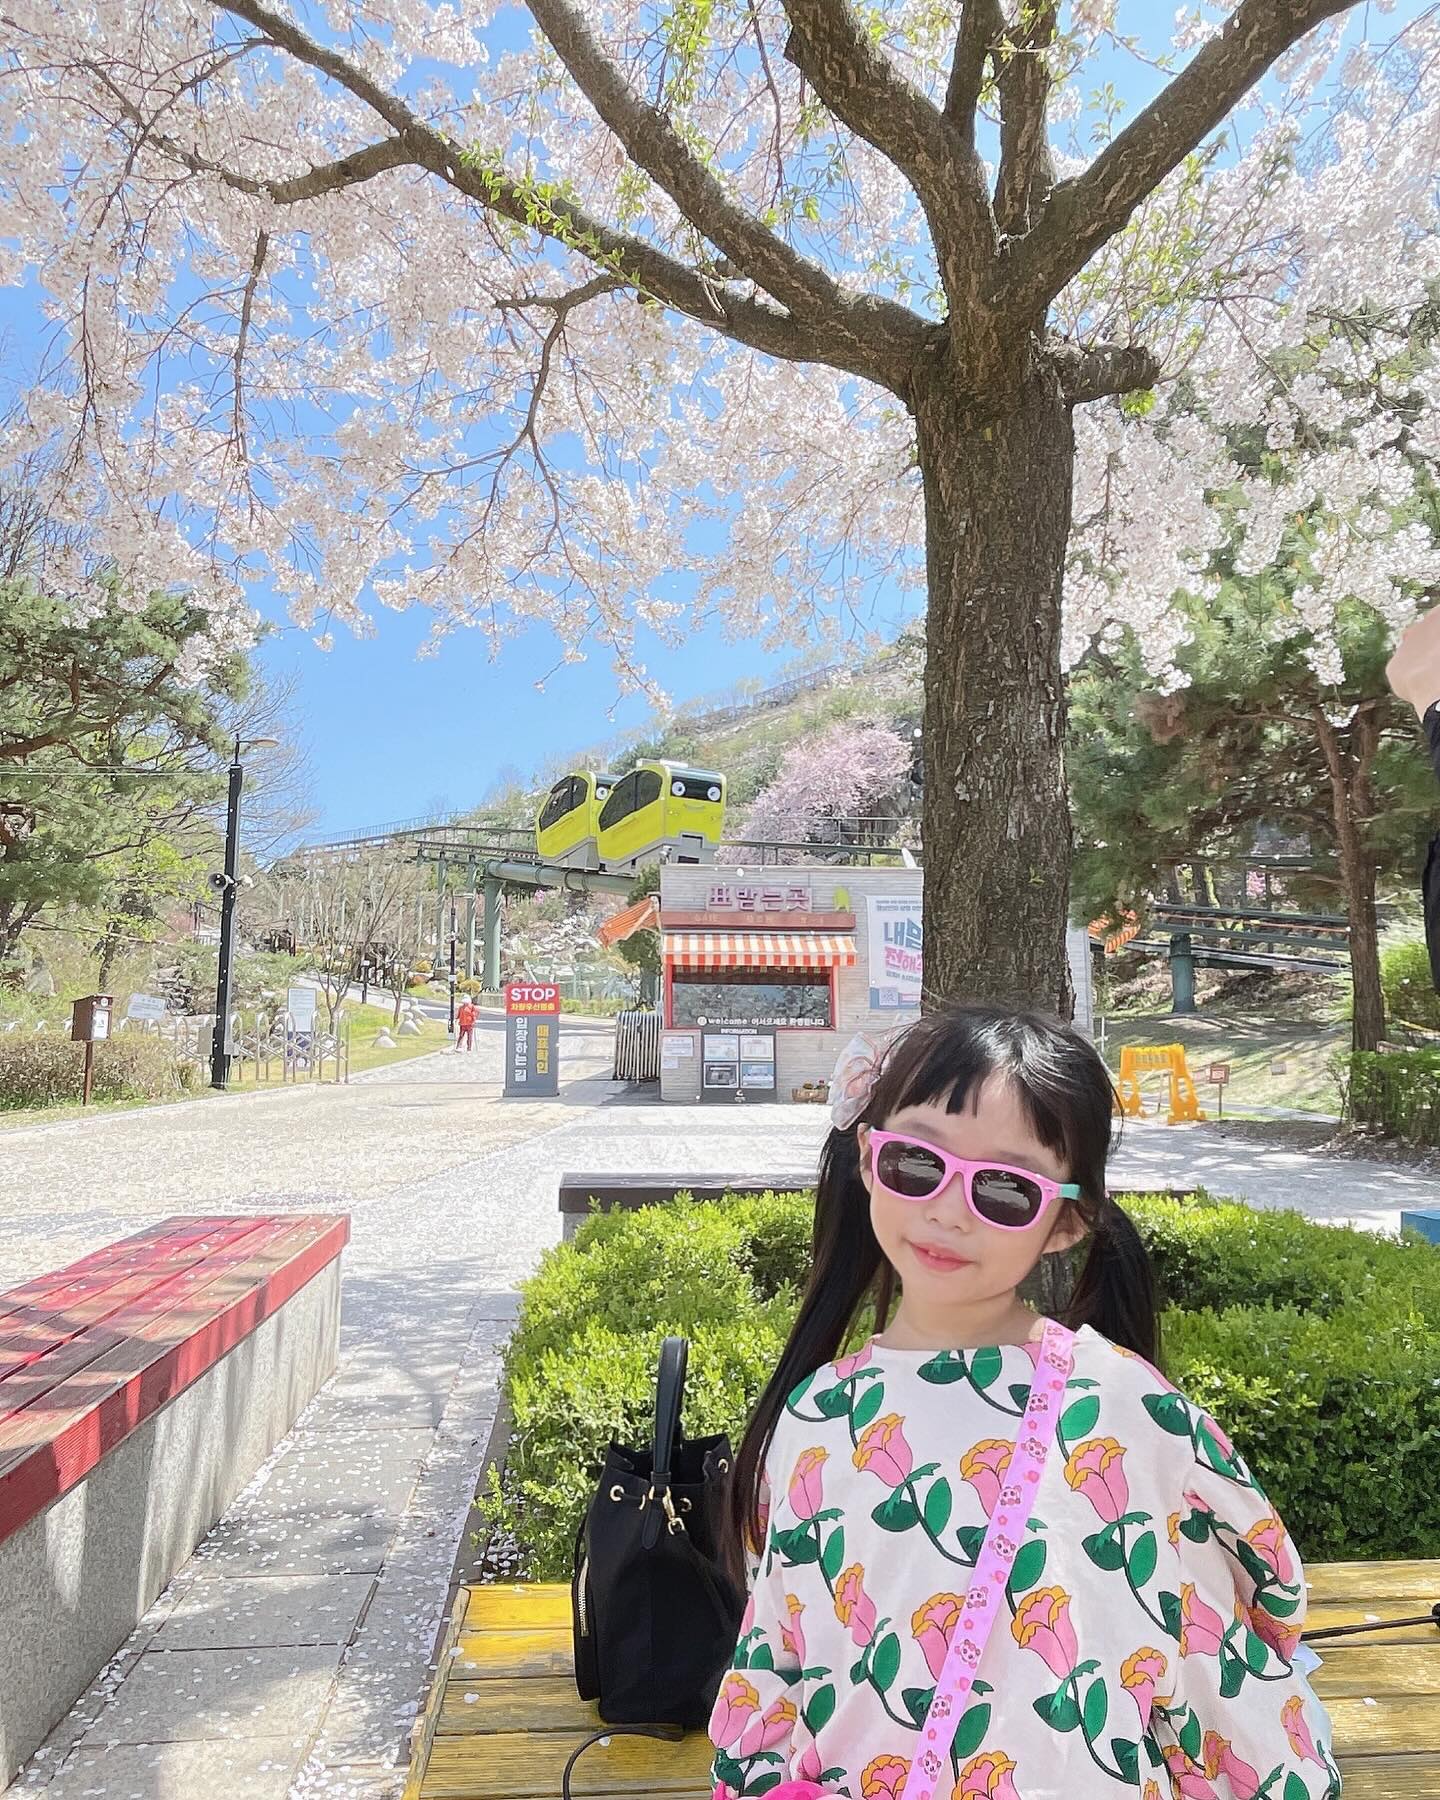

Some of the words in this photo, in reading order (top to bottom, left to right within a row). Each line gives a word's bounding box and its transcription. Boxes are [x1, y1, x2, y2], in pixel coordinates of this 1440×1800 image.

[511, 987, 556, 1002] STOP
[707, 1017, 748, 1026] welcome
[751, 1017, 787, 1026] 어서오세요
